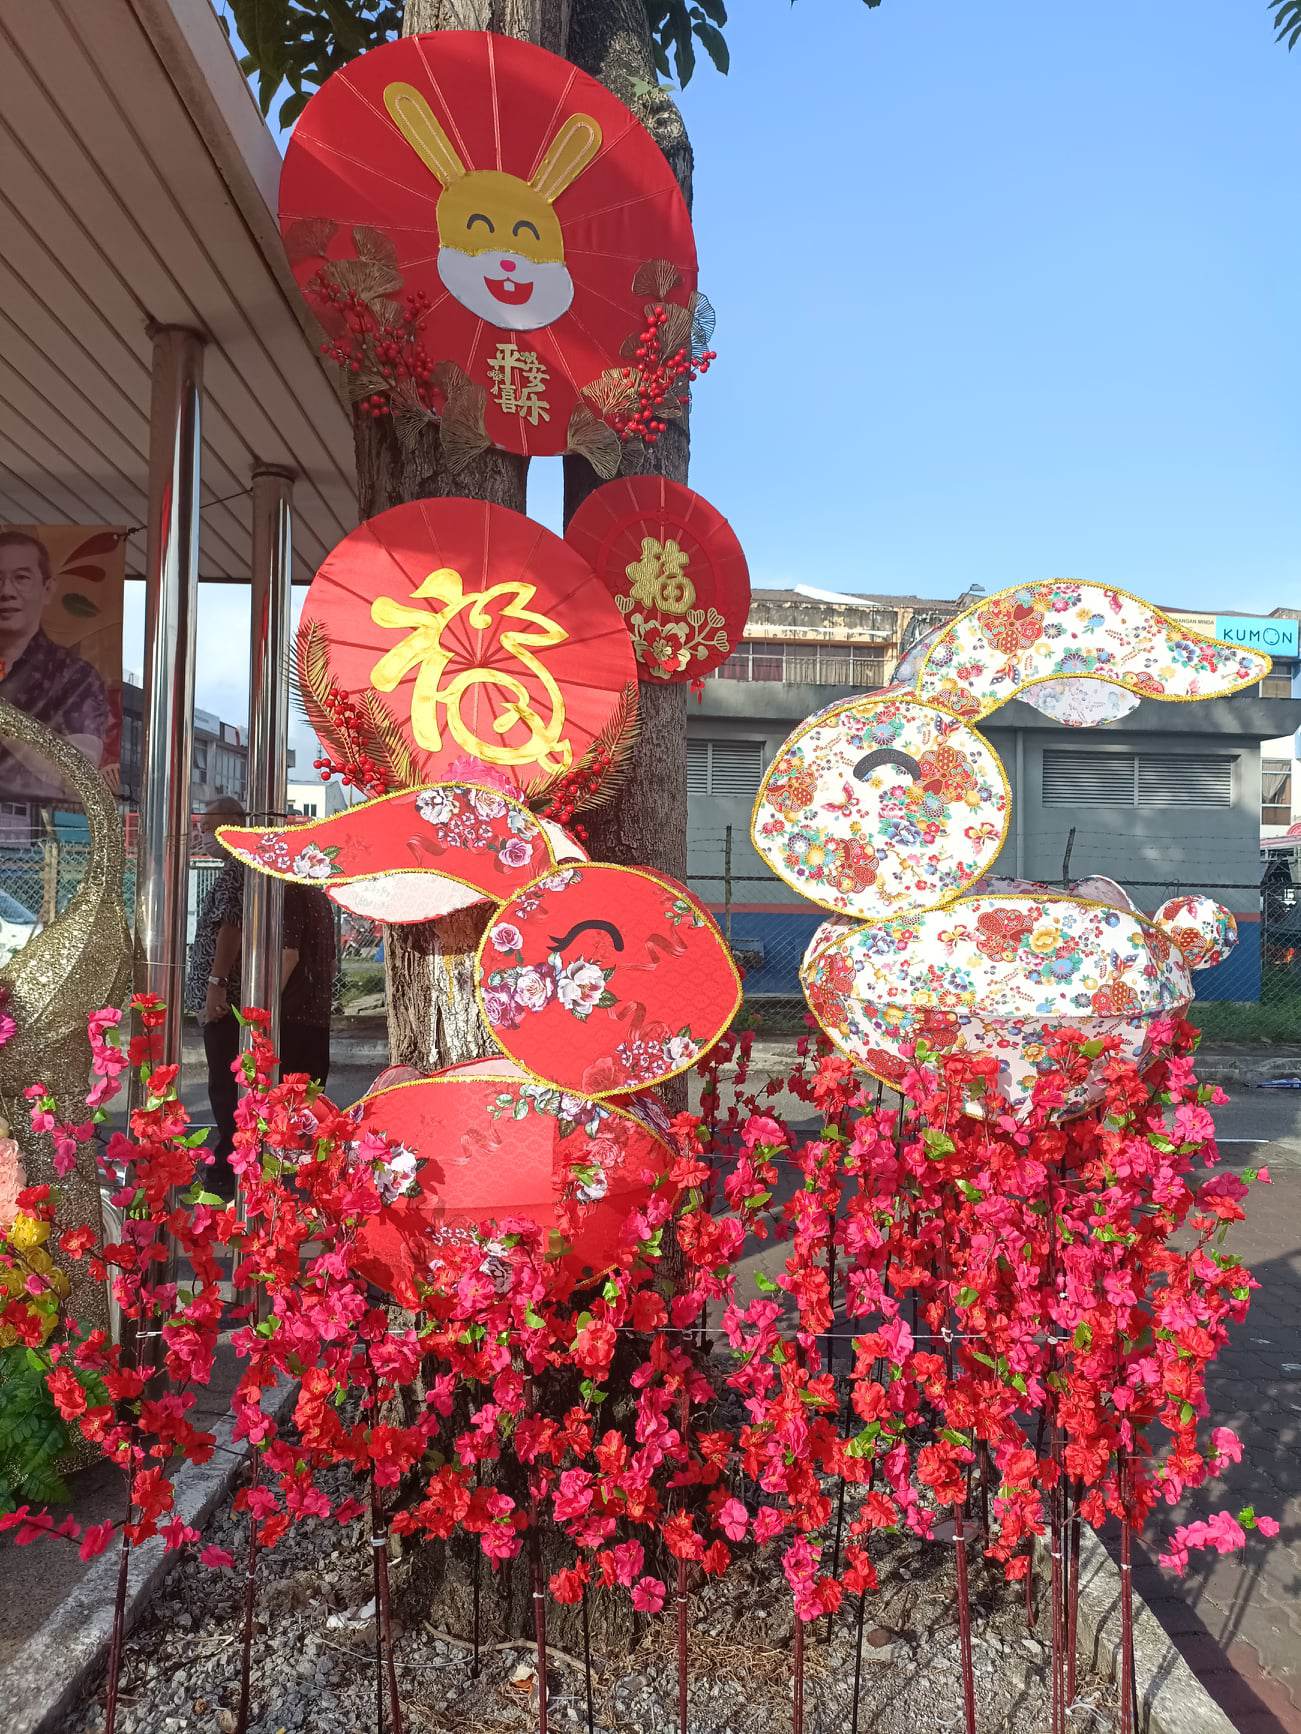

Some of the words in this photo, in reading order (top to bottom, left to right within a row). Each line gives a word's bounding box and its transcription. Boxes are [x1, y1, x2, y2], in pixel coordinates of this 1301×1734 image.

[626, 536, 697, 616] 福
[370, 567, 574, 775] 福
[1223, 627, 1293, 646] KUMON
